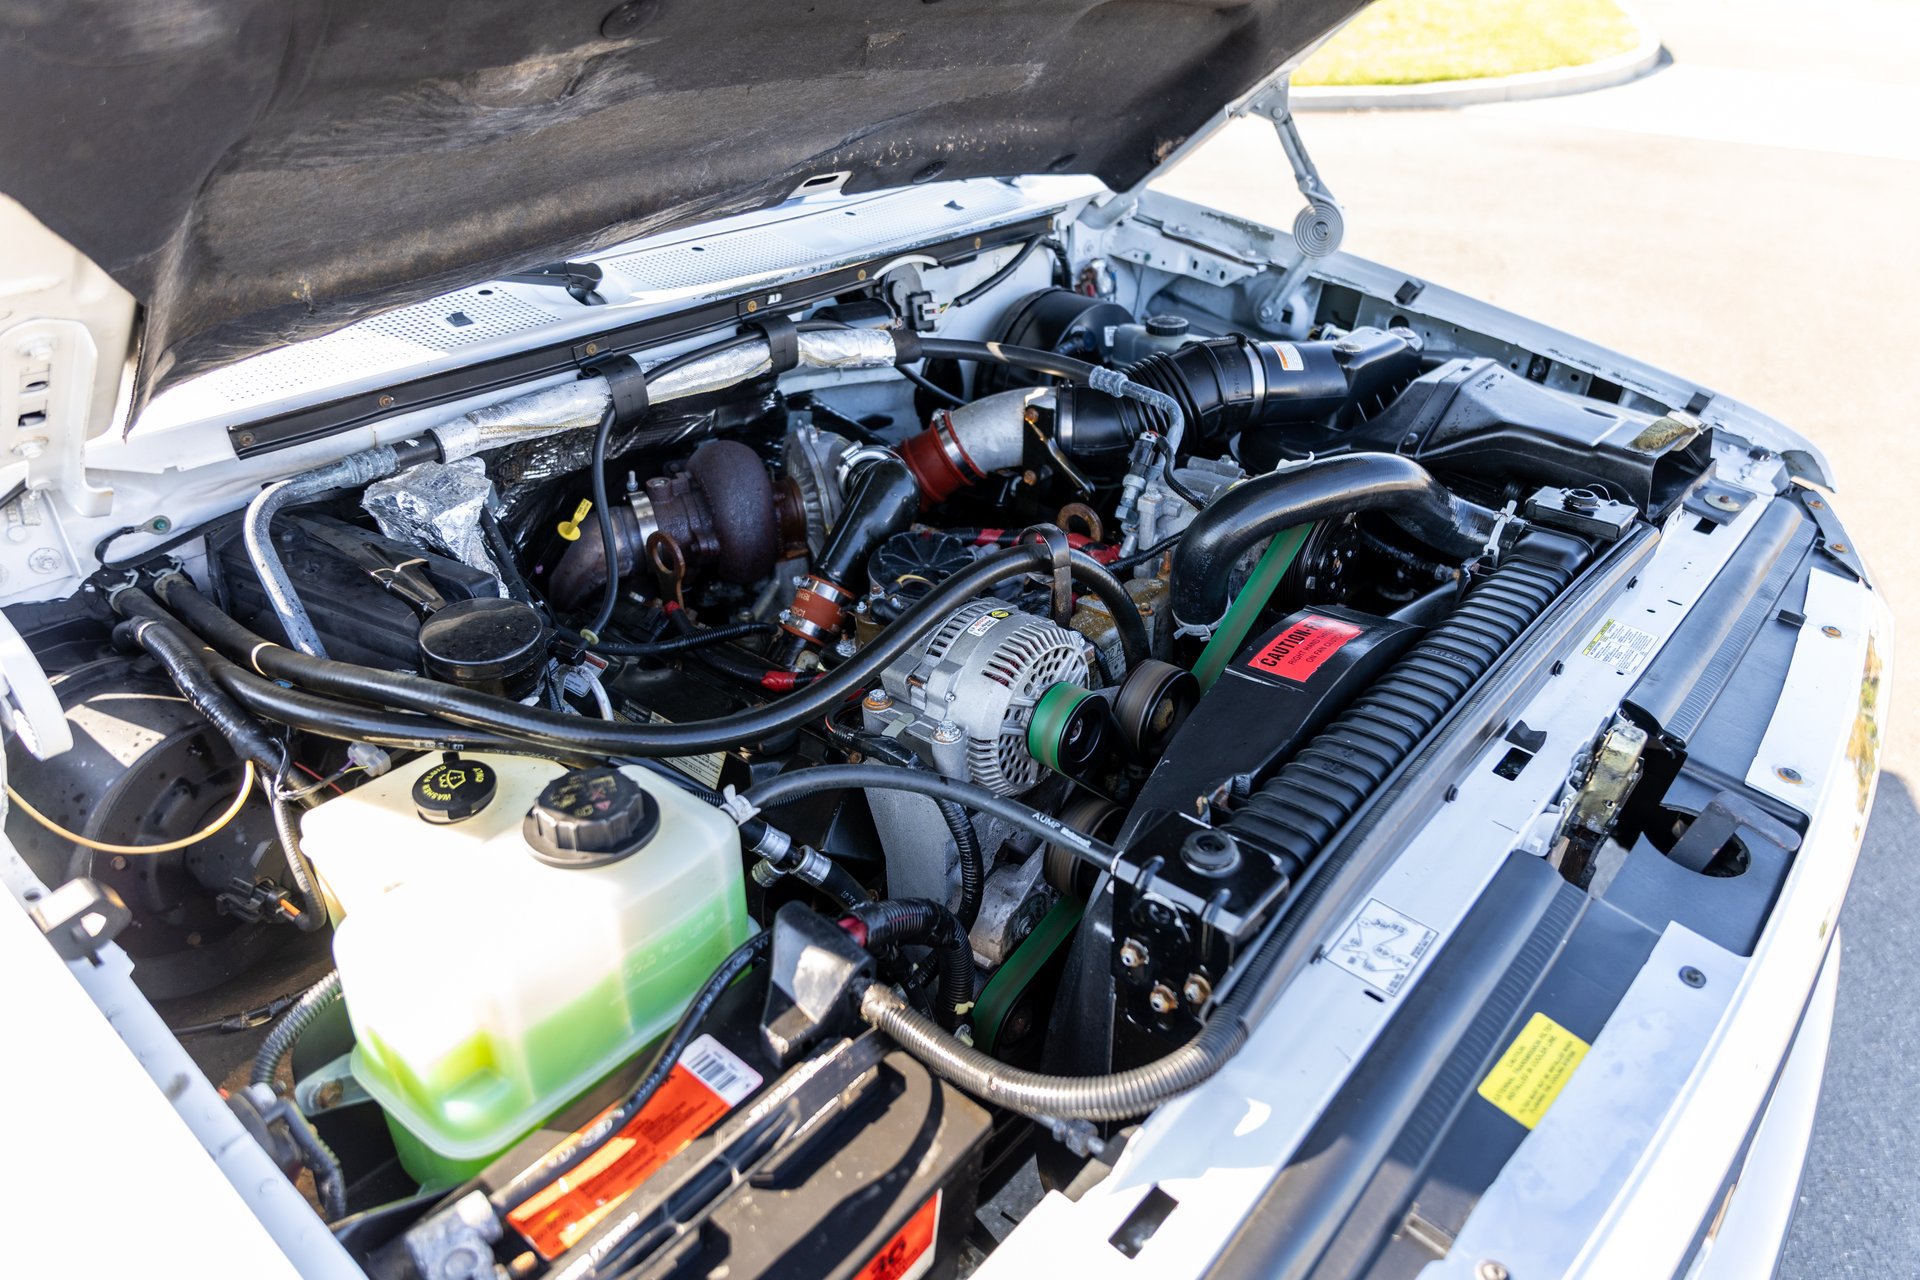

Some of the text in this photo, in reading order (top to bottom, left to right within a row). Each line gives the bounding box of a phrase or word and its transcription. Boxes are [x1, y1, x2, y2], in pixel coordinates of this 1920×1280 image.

[1303, 639, 1321, 651] HAND
[1306, 654, 1317, 662] ON
[1313, 645, 1327, 655] FAN
